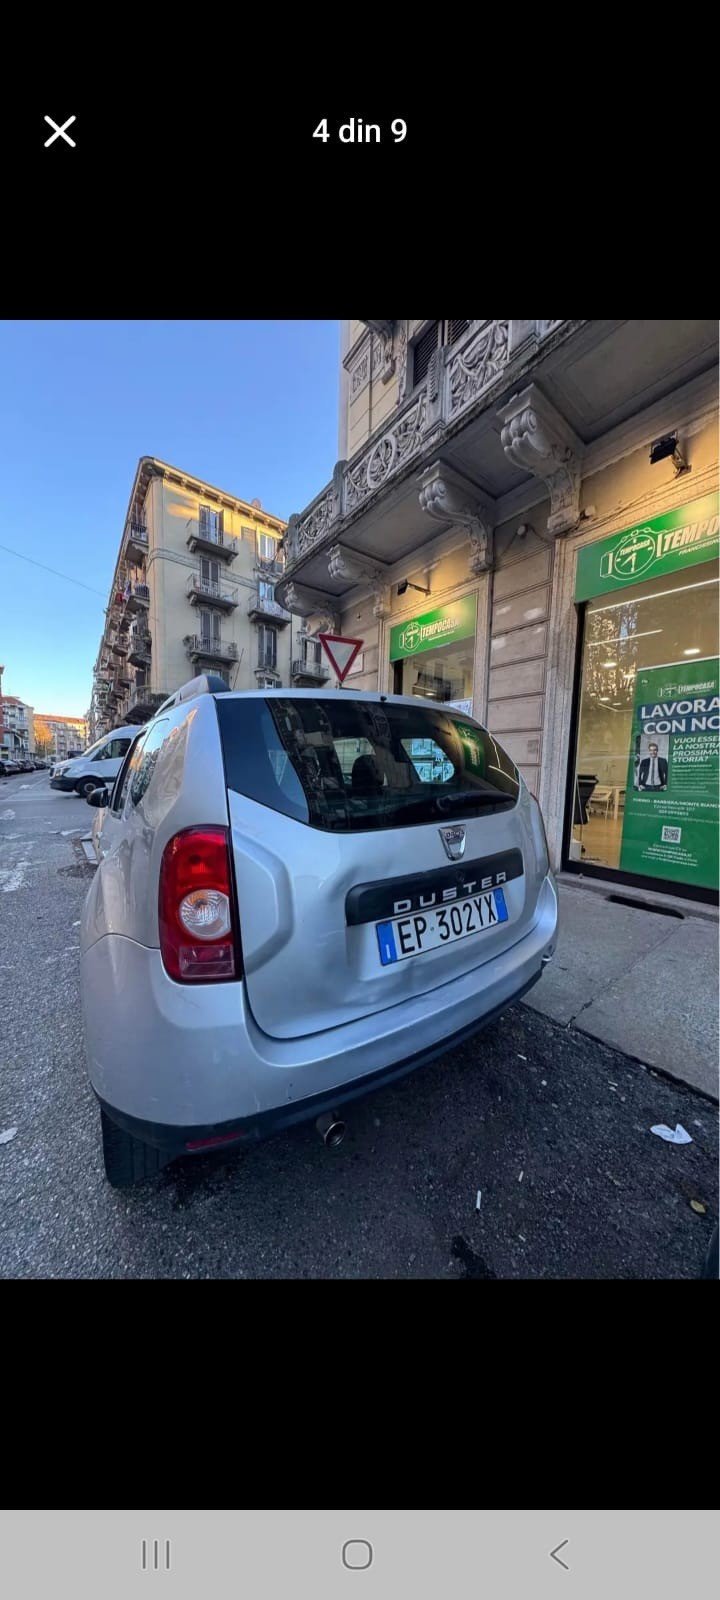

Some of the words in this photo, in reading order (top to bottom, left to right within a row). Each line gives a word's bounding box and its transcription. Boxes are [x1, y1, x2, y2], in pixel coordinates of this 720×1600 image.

[641, 697, 719, 719] LAVORA
[643, 719, 686, 735] CON
[690, 715, 719, 732] NO
[674, 736, 696, 744] VUOI
[672, 749, 719, 757] PROSSIMA
[393, 871, 507, 914] DUSTER
[397, 916, 428, 954] EP
[435, 893, 497, 940] 302YX
